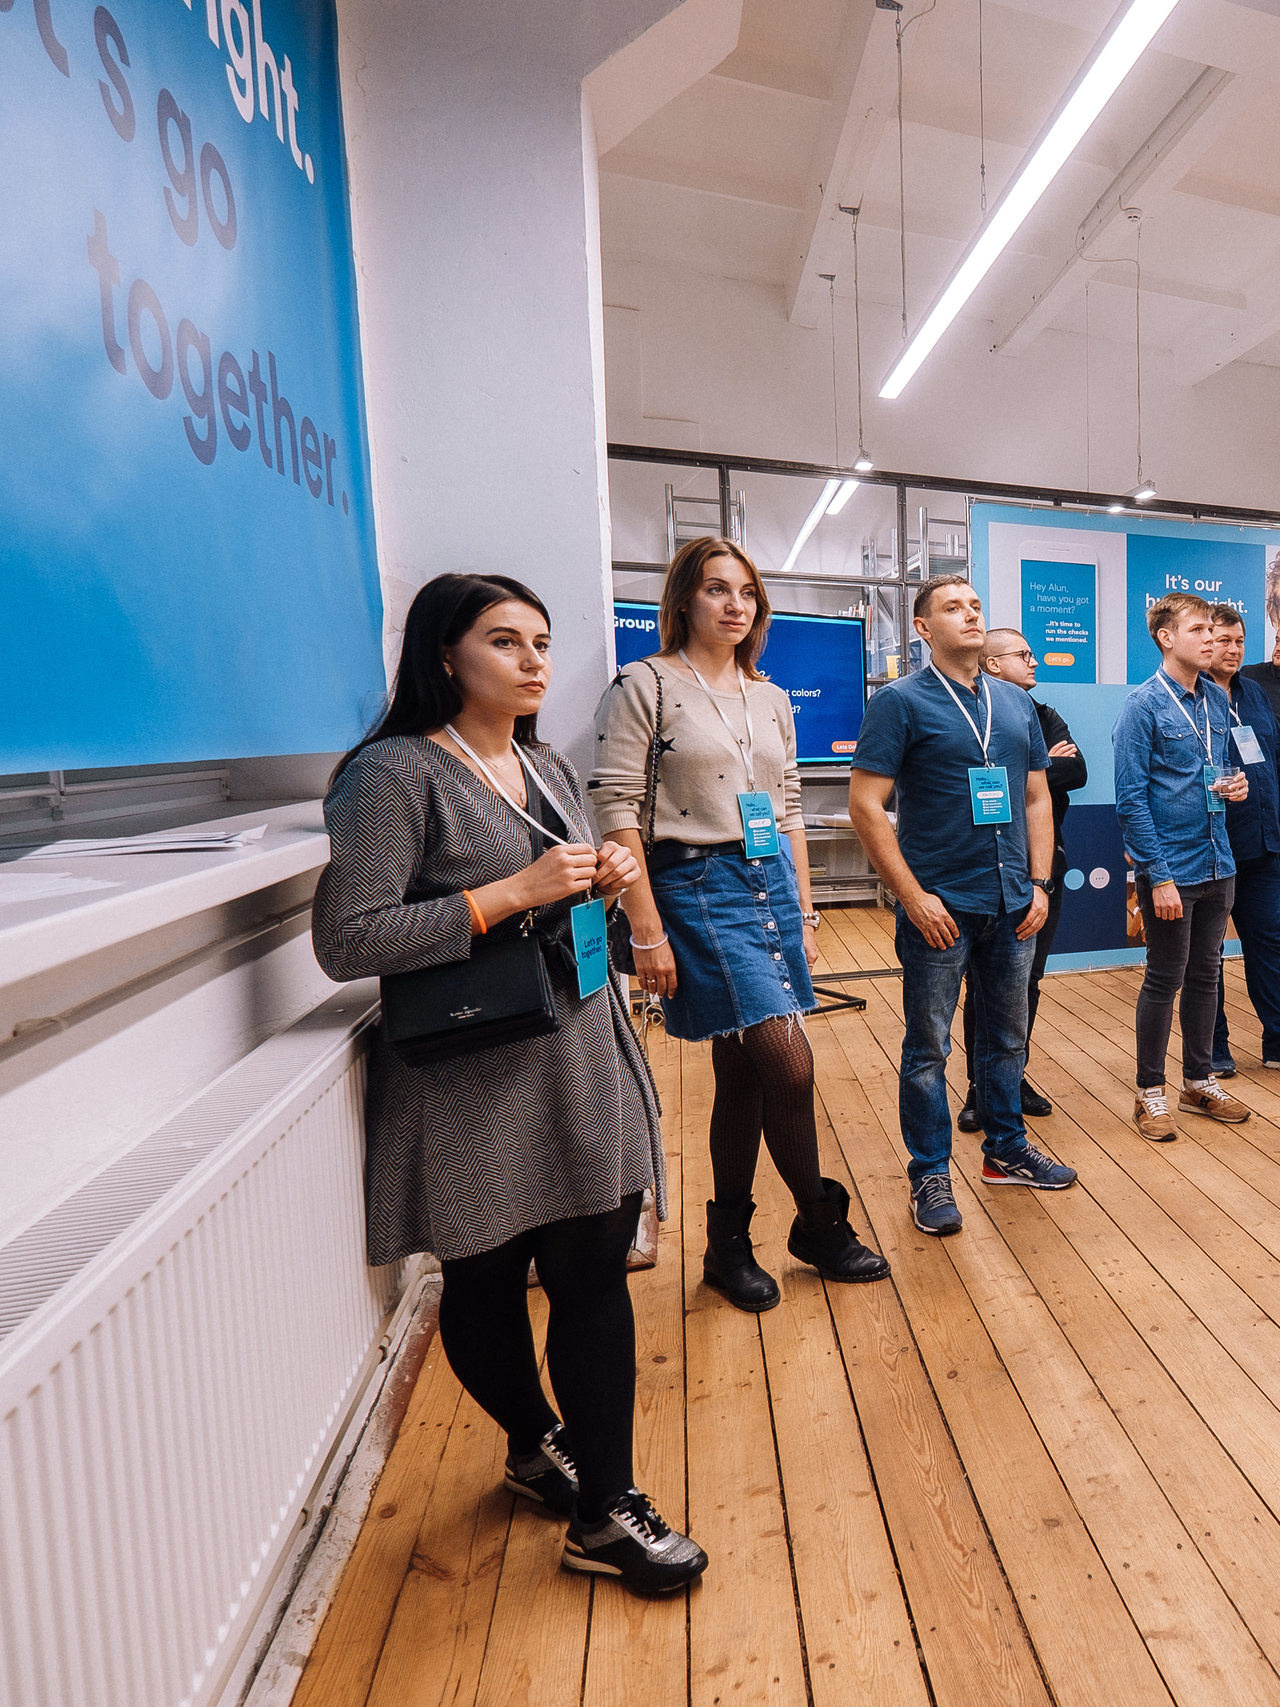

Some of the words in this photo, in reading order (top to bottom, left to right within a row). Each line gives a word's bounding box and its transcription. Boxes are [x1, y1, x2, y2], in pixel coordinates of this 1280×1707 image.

[183, 0, 314, 184] ght.
[157, 88, 237, 250] go
[86, 207, 349, 516] together.
[1029, 582, 1046, 593] Hey
[1048, 583, 1069, 593] Alun,
[1165, 574, 1190, 590] It's
[1194, 579, 1223, 592] our
[1036, 593, 1057, 602] have
[1058, 596, 1074, 605] you
[1075, 596, 1089, 605] got
[1036, 605, 1075, 614] moment?
[791, 688, 822, 698] colors?
[583, 937, 596, 948] Let's
[596, 935, 603, 945] go
